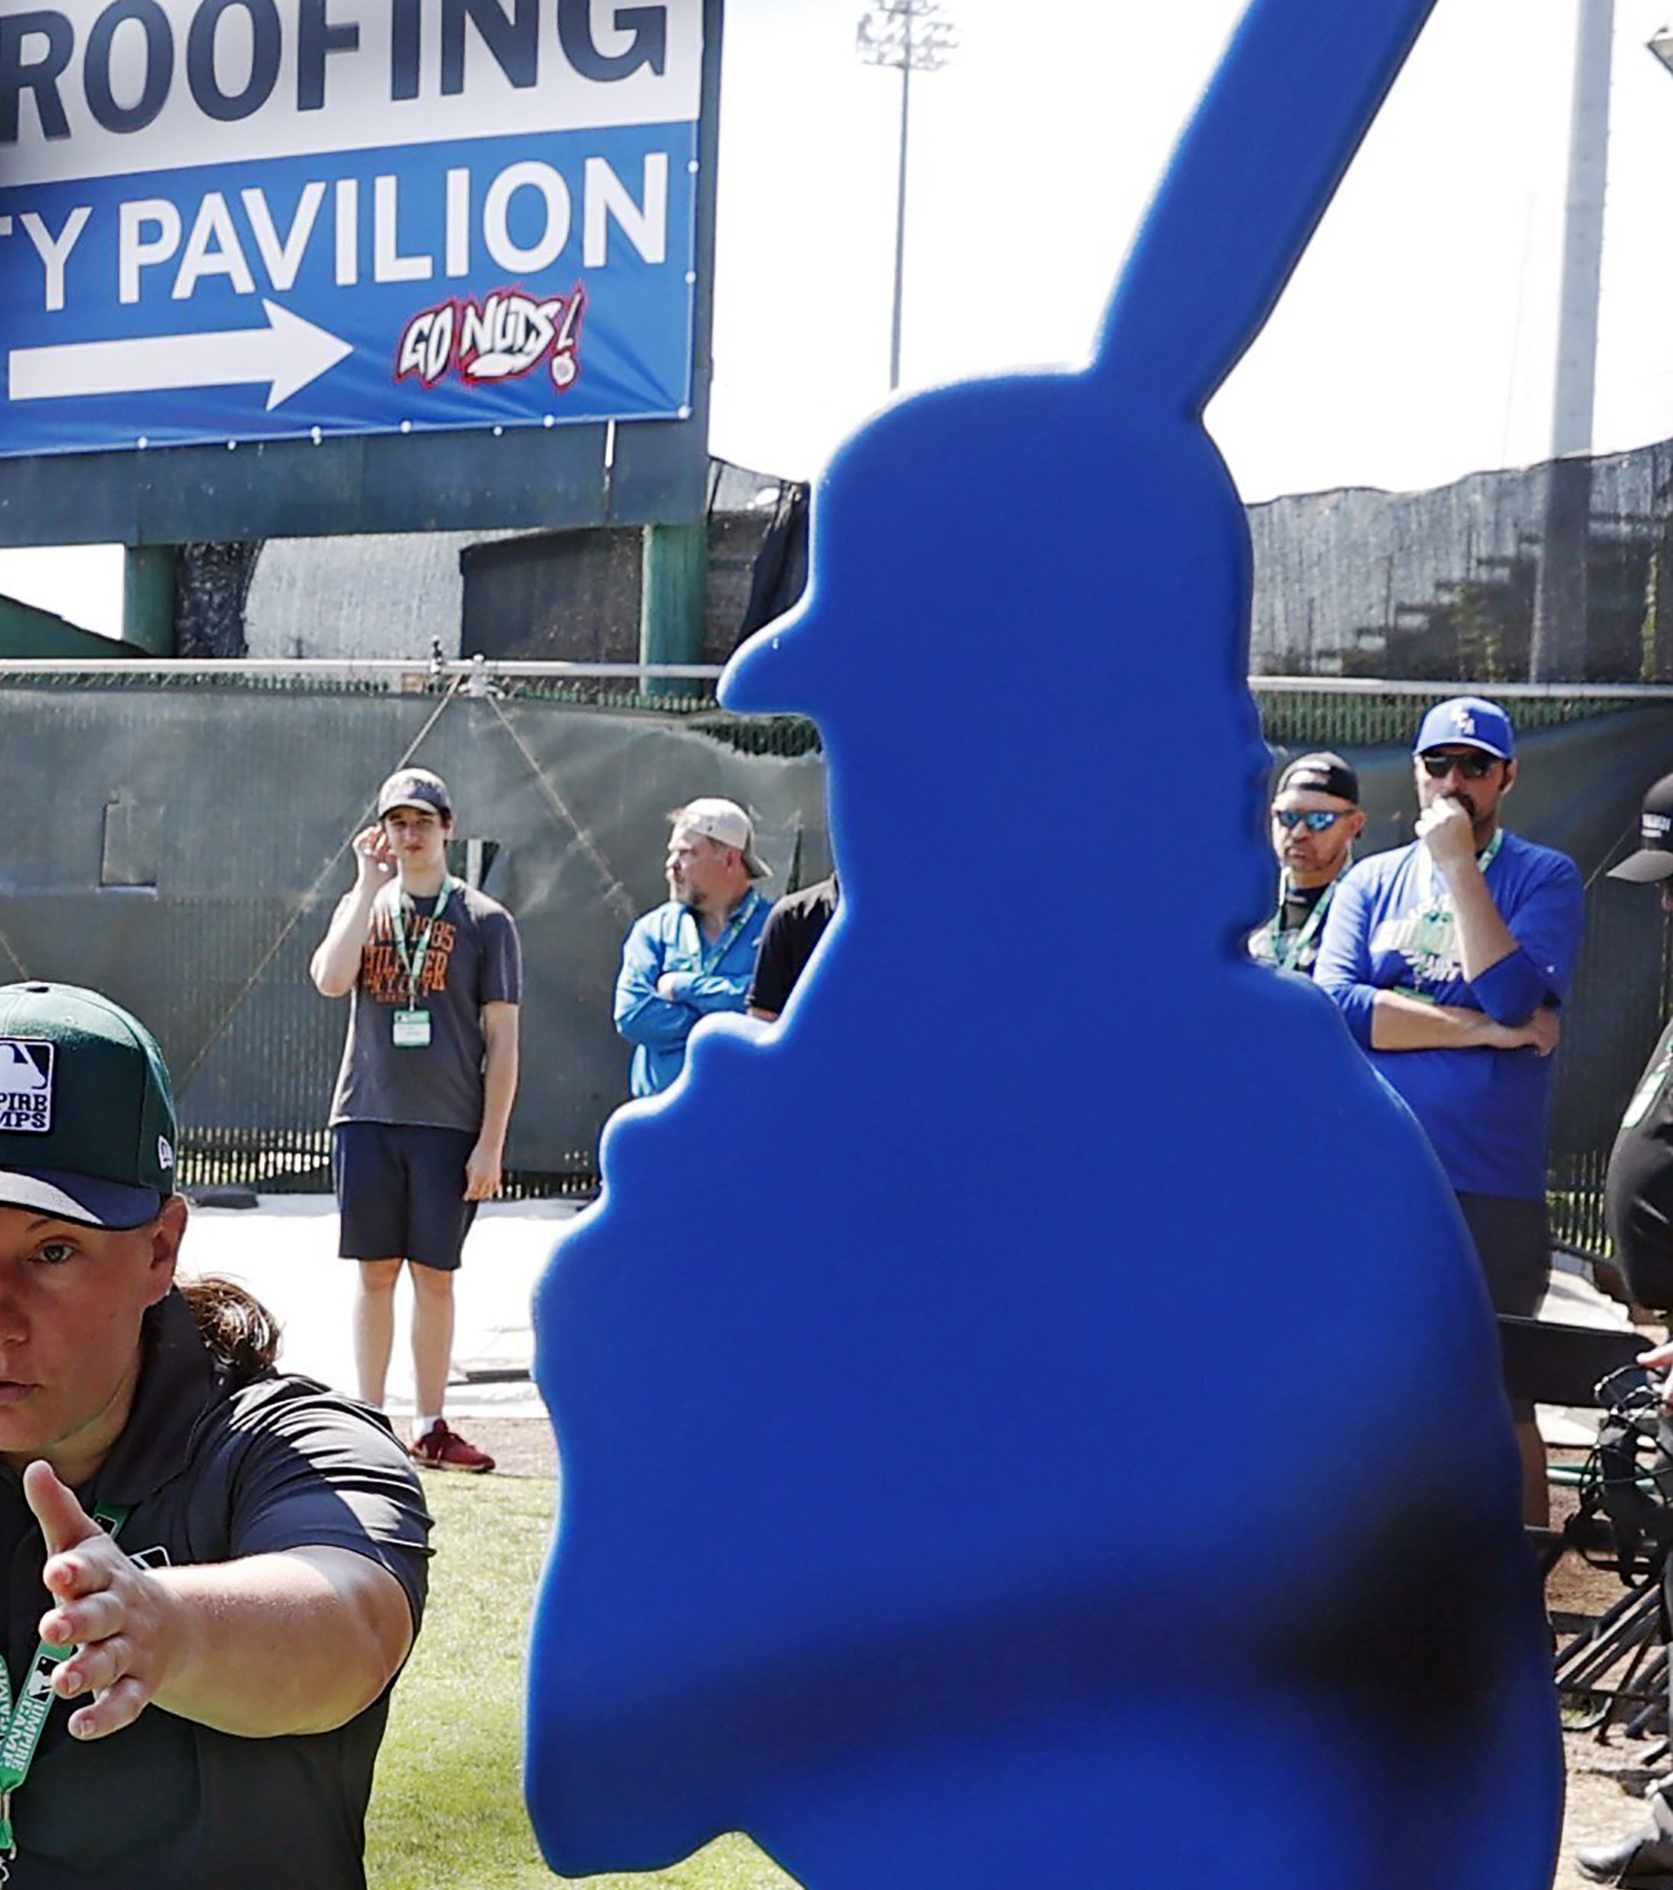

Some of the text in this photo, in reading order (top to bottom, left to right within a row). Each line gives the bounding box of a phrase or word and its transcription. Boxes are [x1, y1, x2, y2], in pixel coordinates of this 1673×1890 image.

[117, 152, 668, 305] PAVILION
[399, 305, 454, 381] GO
[12, 1699, 46, 1772] UMPIRE
